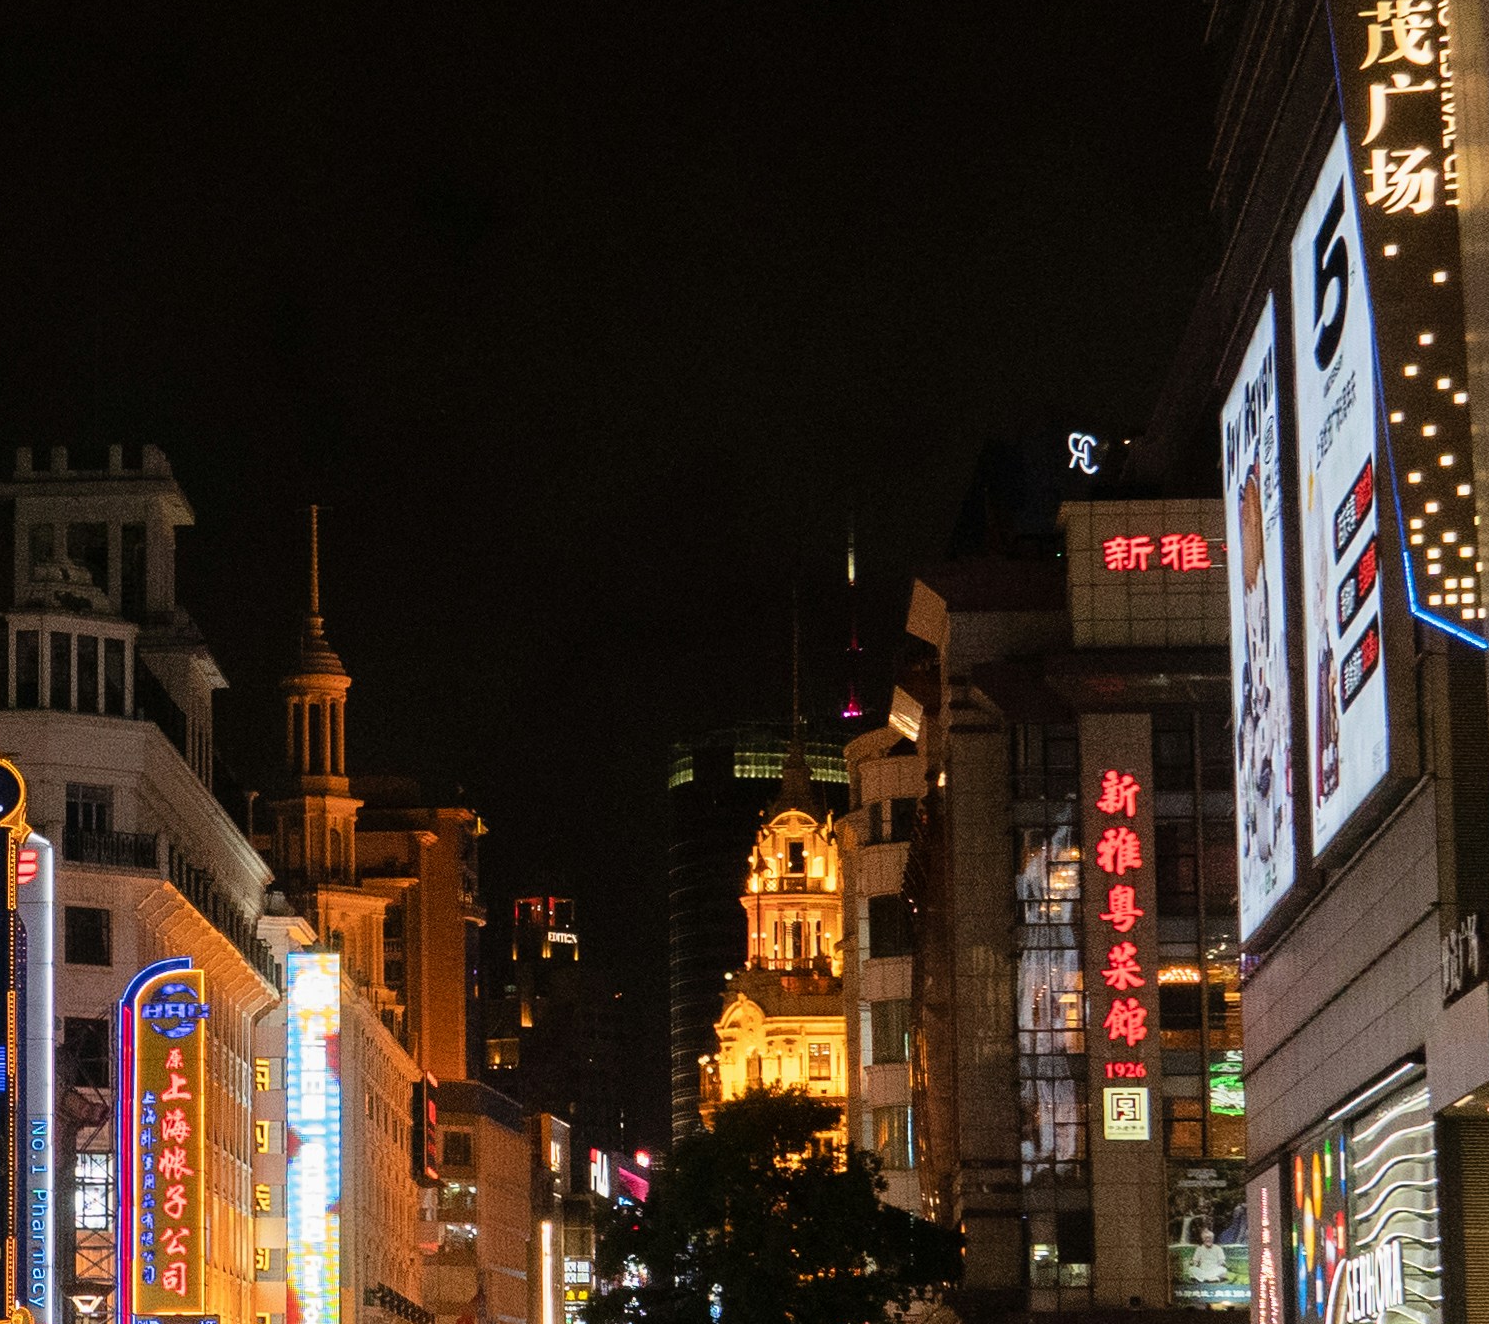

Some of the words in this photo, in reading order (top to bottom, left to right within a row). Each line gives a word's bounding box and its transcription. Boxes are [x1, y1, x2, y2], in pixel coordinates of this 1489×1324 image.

[1102, 532, 1212, 572] 新雅
[1095, 769, 1150, 1047] 新雅粤菜馆
[1104, 1061, 1148, 1080] 1926
[30, 1119, 49, 1175] No.1
[28, 1187, 49, 1308] Pharmacy
[1345, 1240, 1405, 1324] SEPHORA
